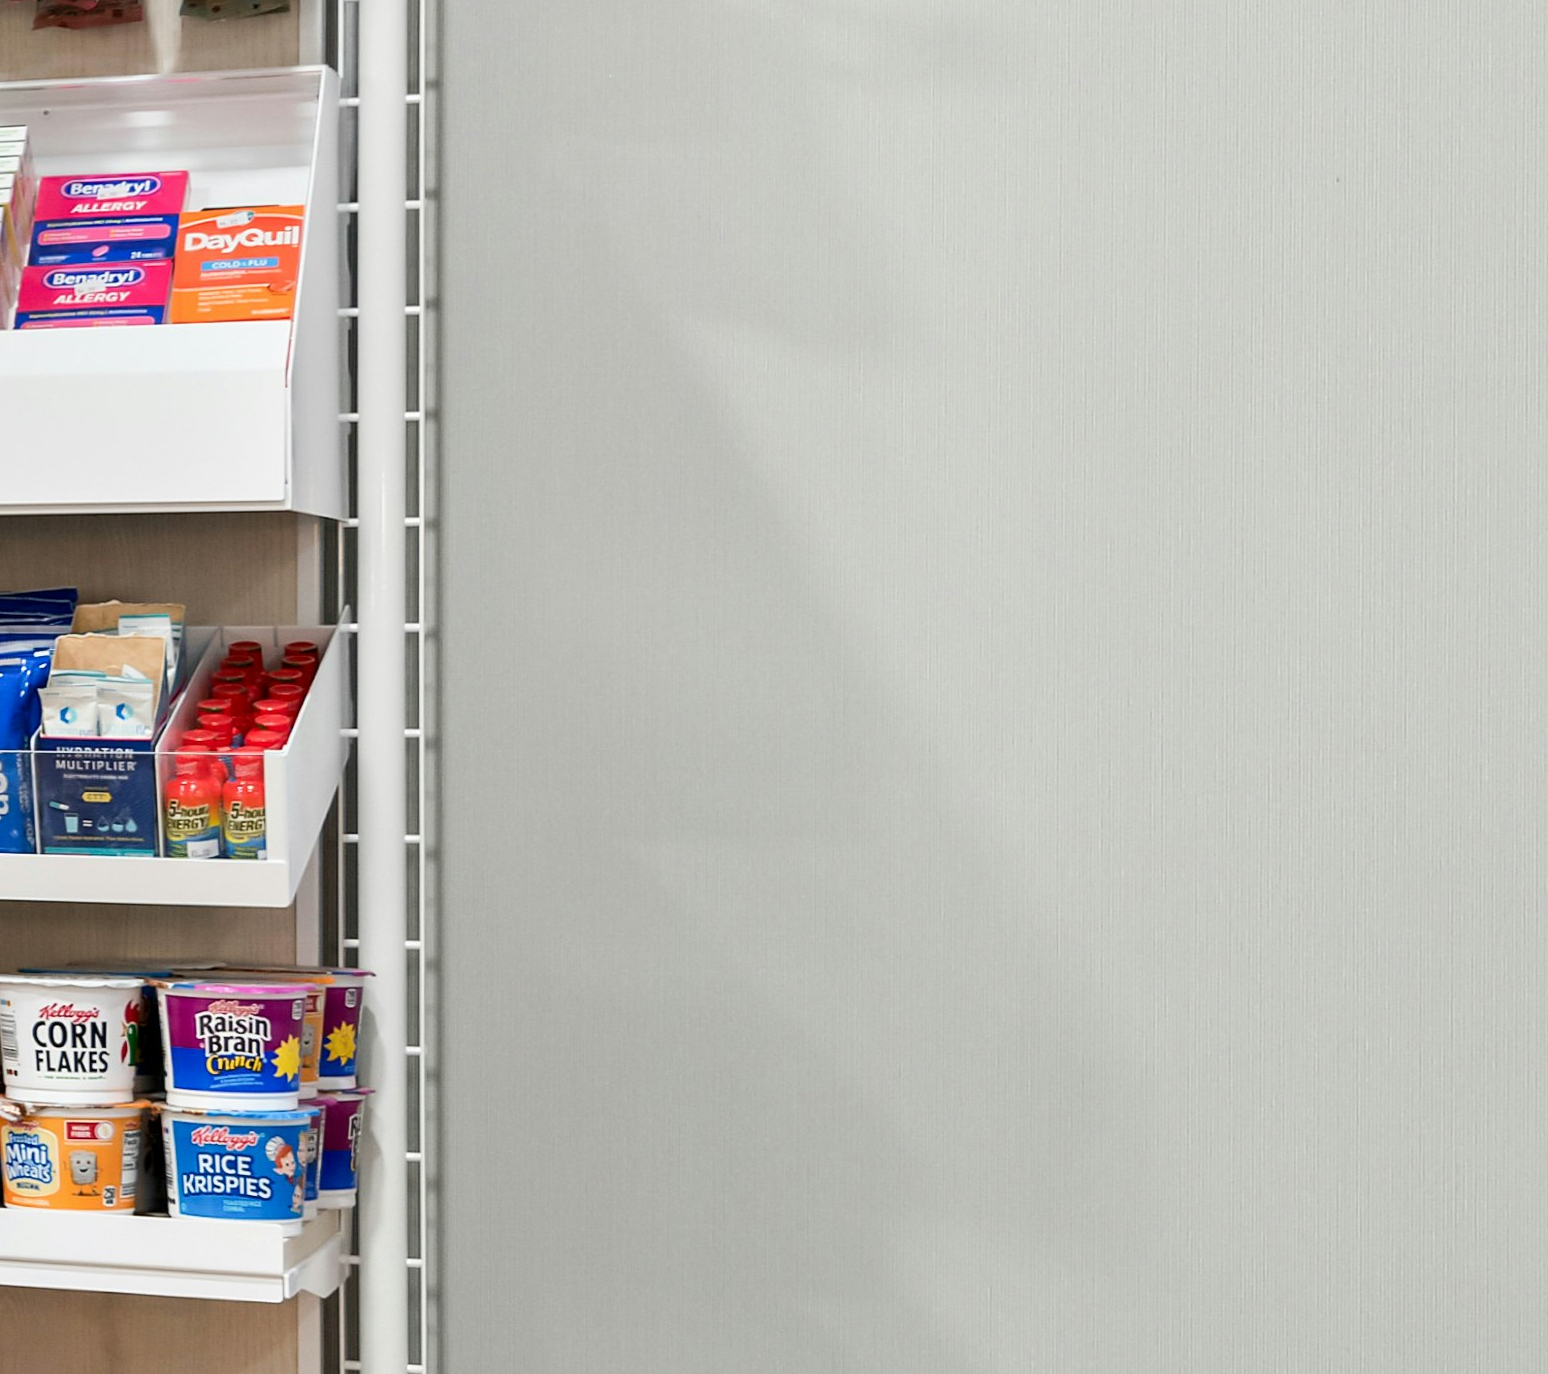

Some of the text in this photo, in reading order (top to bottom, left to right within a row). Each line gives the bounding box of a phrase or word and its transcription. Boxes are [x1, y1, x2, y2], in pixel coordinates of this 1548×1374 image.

[70, 181, 152, 197] Benadryl
[71, 201, 147, 214] ALLERGY
[184, 226, 300, 254] DayQuil
[211, 259, 268, 270] COLD FLU
[51, 271, 136, 287] Benadryl
[53, 291, 131, 305] ALLERGY
[56, 760, 135, 771] MULTIPLIER
[168, 800, 209, 816] 5-hour
[39, 1003, 100, 1023] Kellogg's
[32, 1021, 107, 1049] CORN
[198, 1013, 269, 1037] Raisin
[207, 1036, 262, 1056] Bran
[35, 1050, 109, 1073] FLAKES
[207, 1054, 263, 1075] Crunch
[191, 1127, 257, 1148] Kellogg's
[7, 1144, 48, 1164] Mini
[7, 1164, 51, 1183] Wheats
[198, 1156, 252, 1176] RICE
[183, 1175, 272, 1197] KRISPIES
